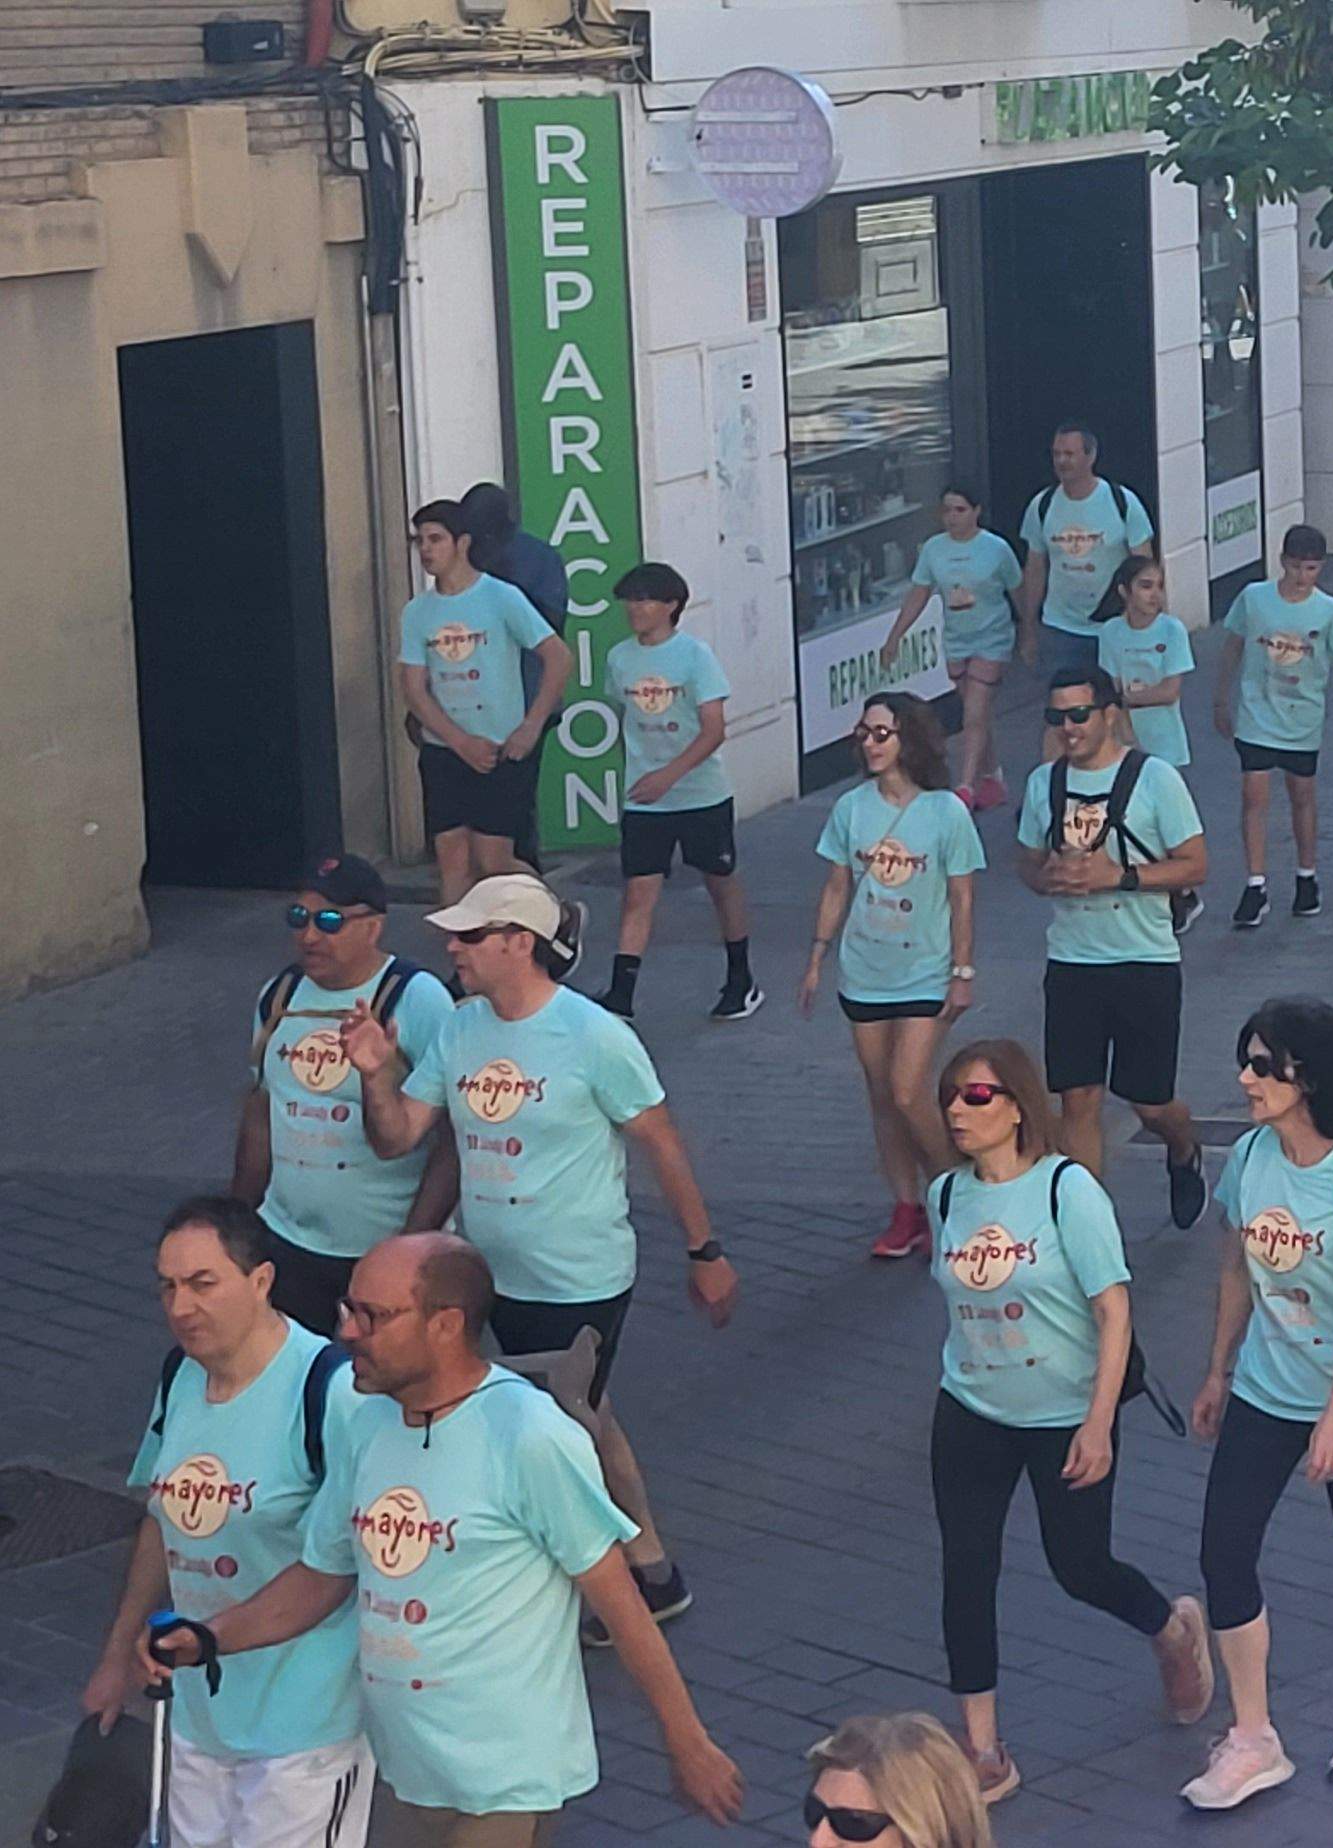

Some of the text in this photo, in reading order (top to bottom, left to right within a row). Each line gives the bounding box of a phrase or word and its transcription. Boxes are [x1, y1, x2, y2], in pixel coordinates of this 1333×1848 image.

[535, 124, 621, 831] REPARACION
[457, 1074, 546, 1107] +mayores
[943, 1238, 1038, 1276] +mayores
[151, 1478, 258, 1518] +mayores
[351, 1506, 459, 1554] +mayores
